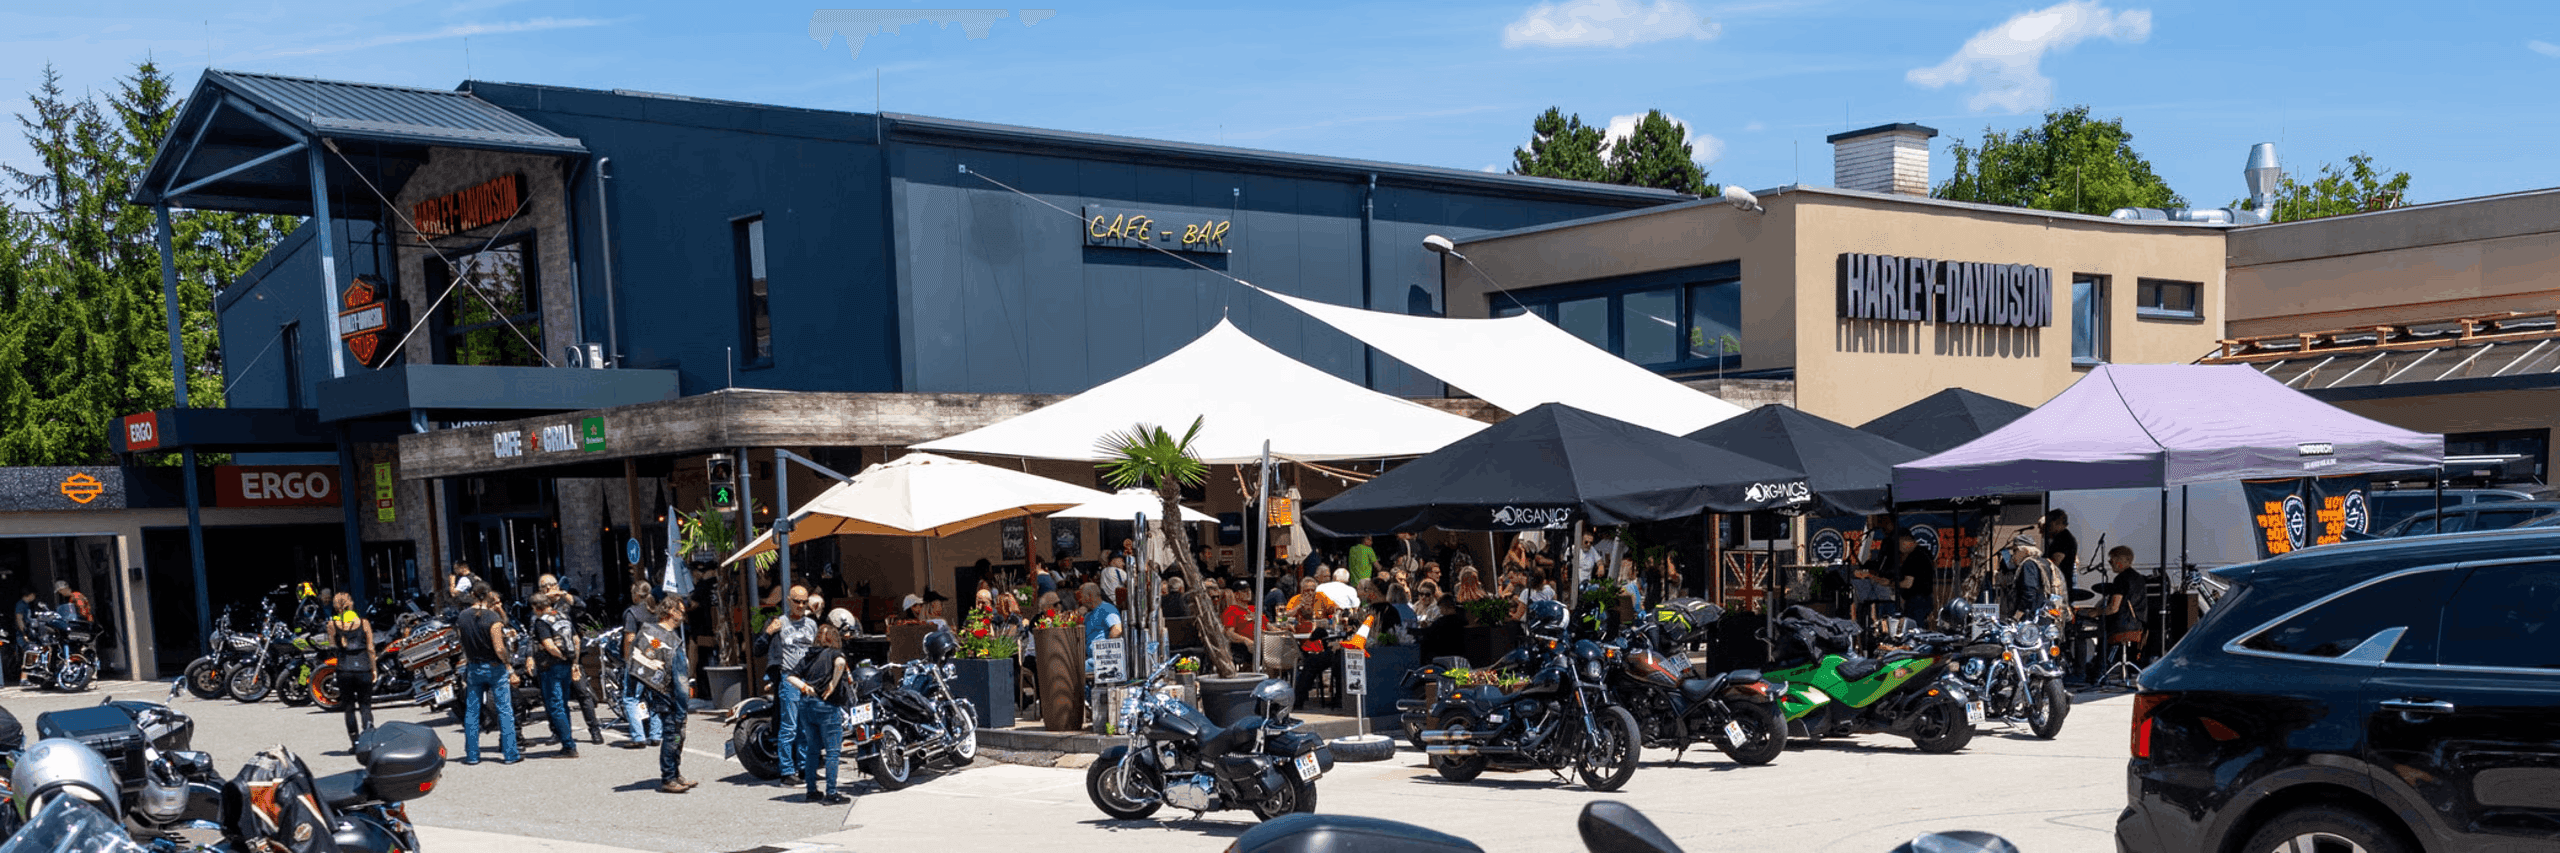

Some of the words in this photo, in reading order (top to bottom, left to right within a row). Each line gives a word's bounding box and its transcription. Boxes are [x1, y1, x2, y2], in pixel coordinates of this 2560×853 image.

[1090, 213, 1153, 241] CAFE
[1182, 220, 1231, 247] BAR
[1846, 252, 2053, 329] HARLEY-DAVIDSON
[129, 421, 153, 443] ERGO
[494, 430, 522, 458] CAFE
[543, 423, 578, 453] GRILL
[240, 471, 331, 500] ERGO
[1752, 482, 1809, 503] ORGANICS
[1502, 505, 1572, 526] ORGANICS
[1095, 642, 1121, 650] RESERVED
